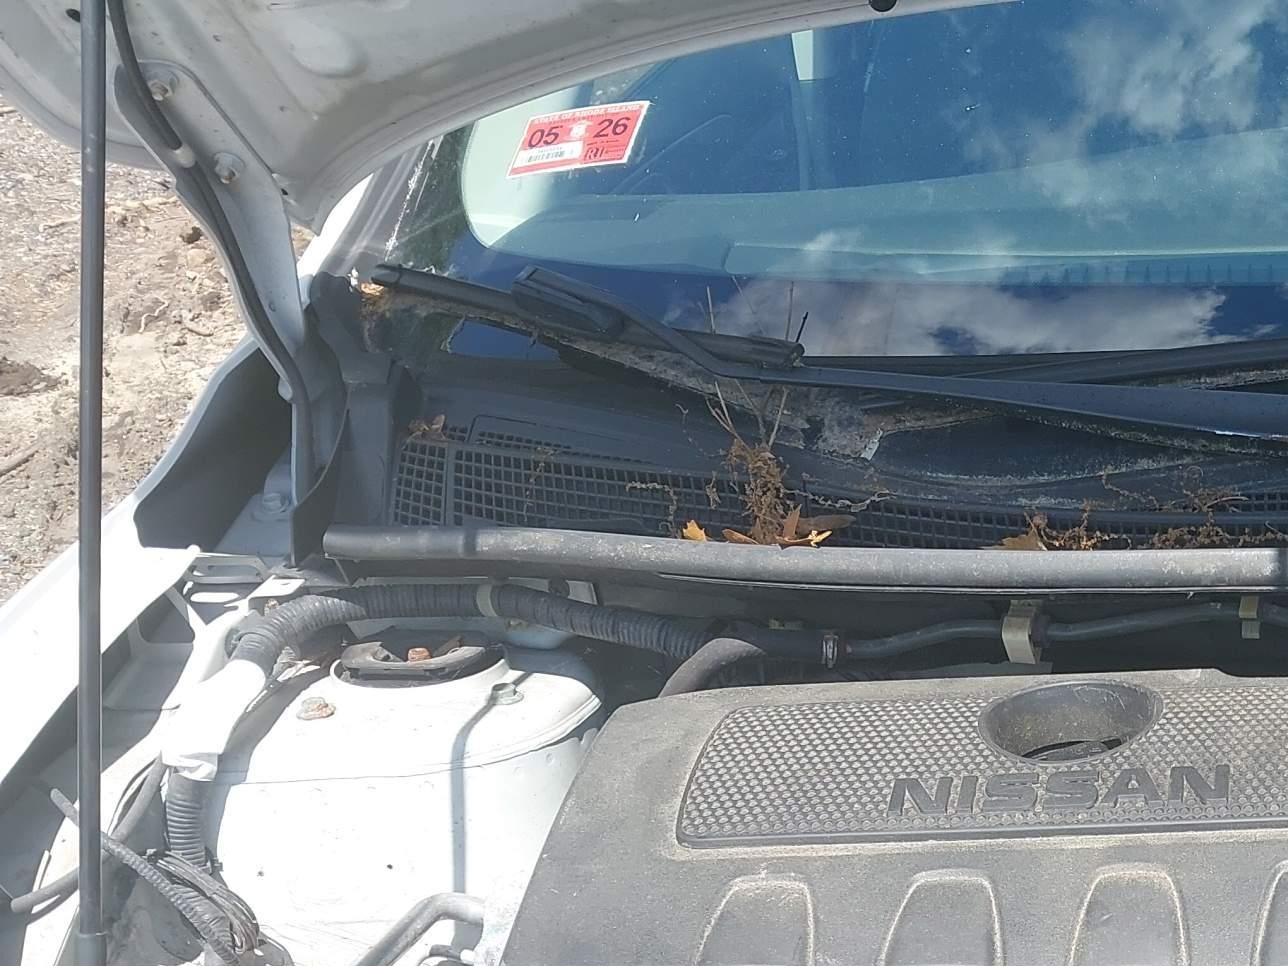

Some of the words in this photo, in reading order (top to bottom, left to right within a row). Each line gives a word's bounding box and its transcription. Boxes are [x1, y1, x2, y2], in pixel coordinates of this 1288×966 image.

[527, 125, 563, 148] 05
[592, 116, 631, 138] 26
[886, 764, 1232, 817] NISSAN
